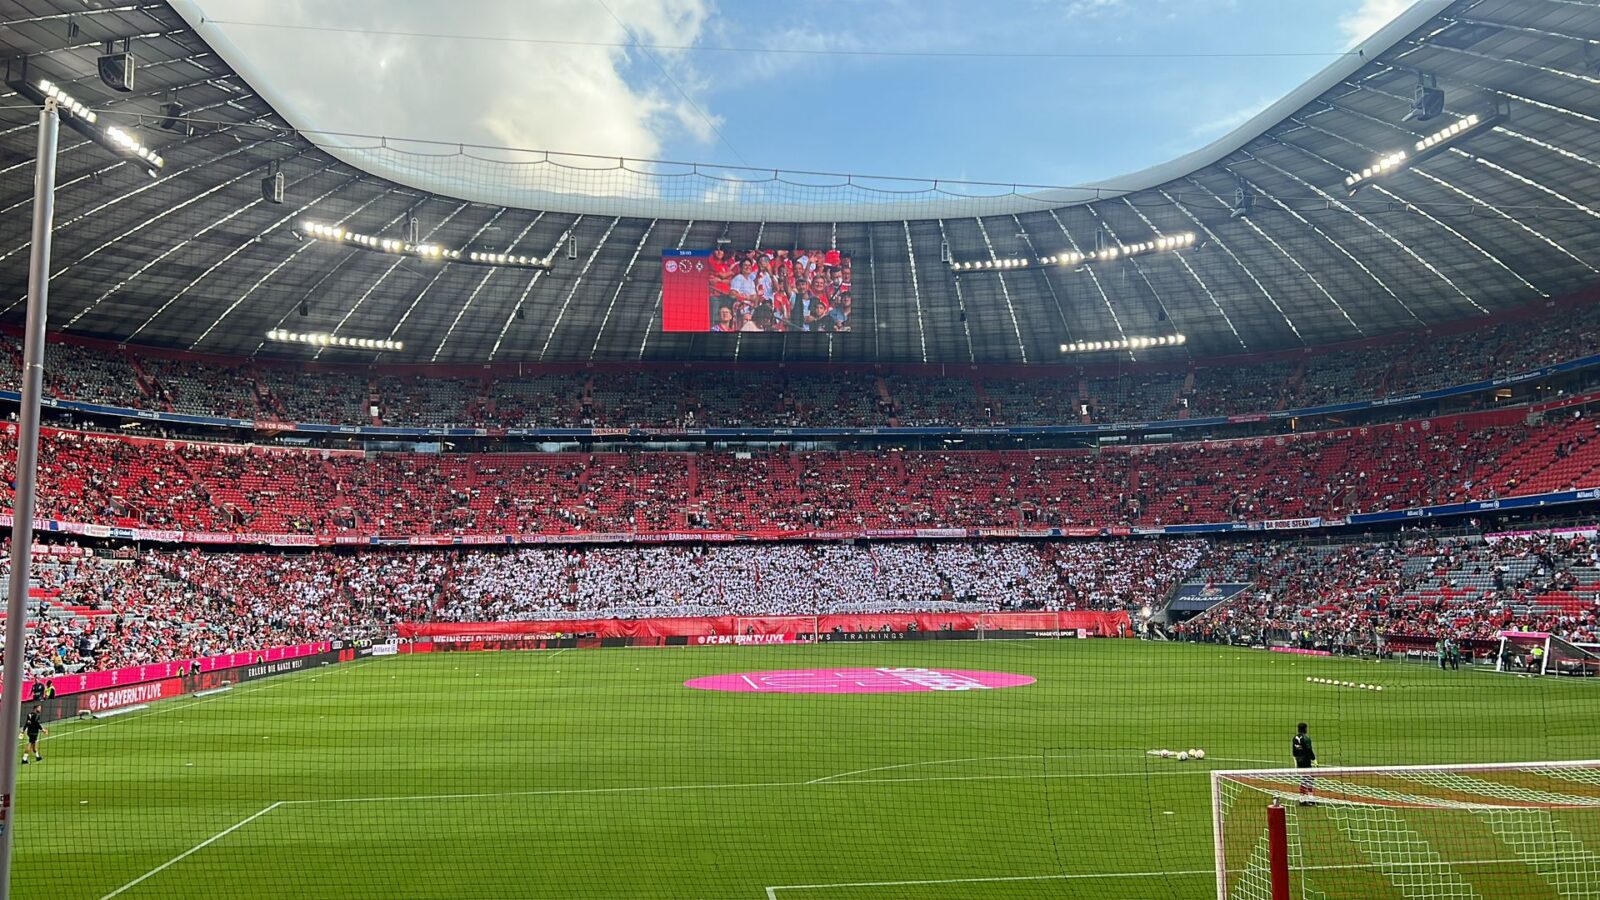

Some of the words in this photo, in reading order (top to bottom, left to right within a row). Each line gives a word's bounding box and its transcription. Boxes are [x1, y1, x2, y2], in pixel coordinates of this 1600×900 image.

[706, 635, 718, 643] FC
[765, 634, 784, 643] LIVE
[248, 666, 267, 677] ERLEBE
[268, 665, 276, 673] DIE
[277, 661, 291, 671] GANZE
[291, 659, 303, 668] WELT
[97, 692, 108, 709] FC
[147, 683, 162, 700] LIVE
